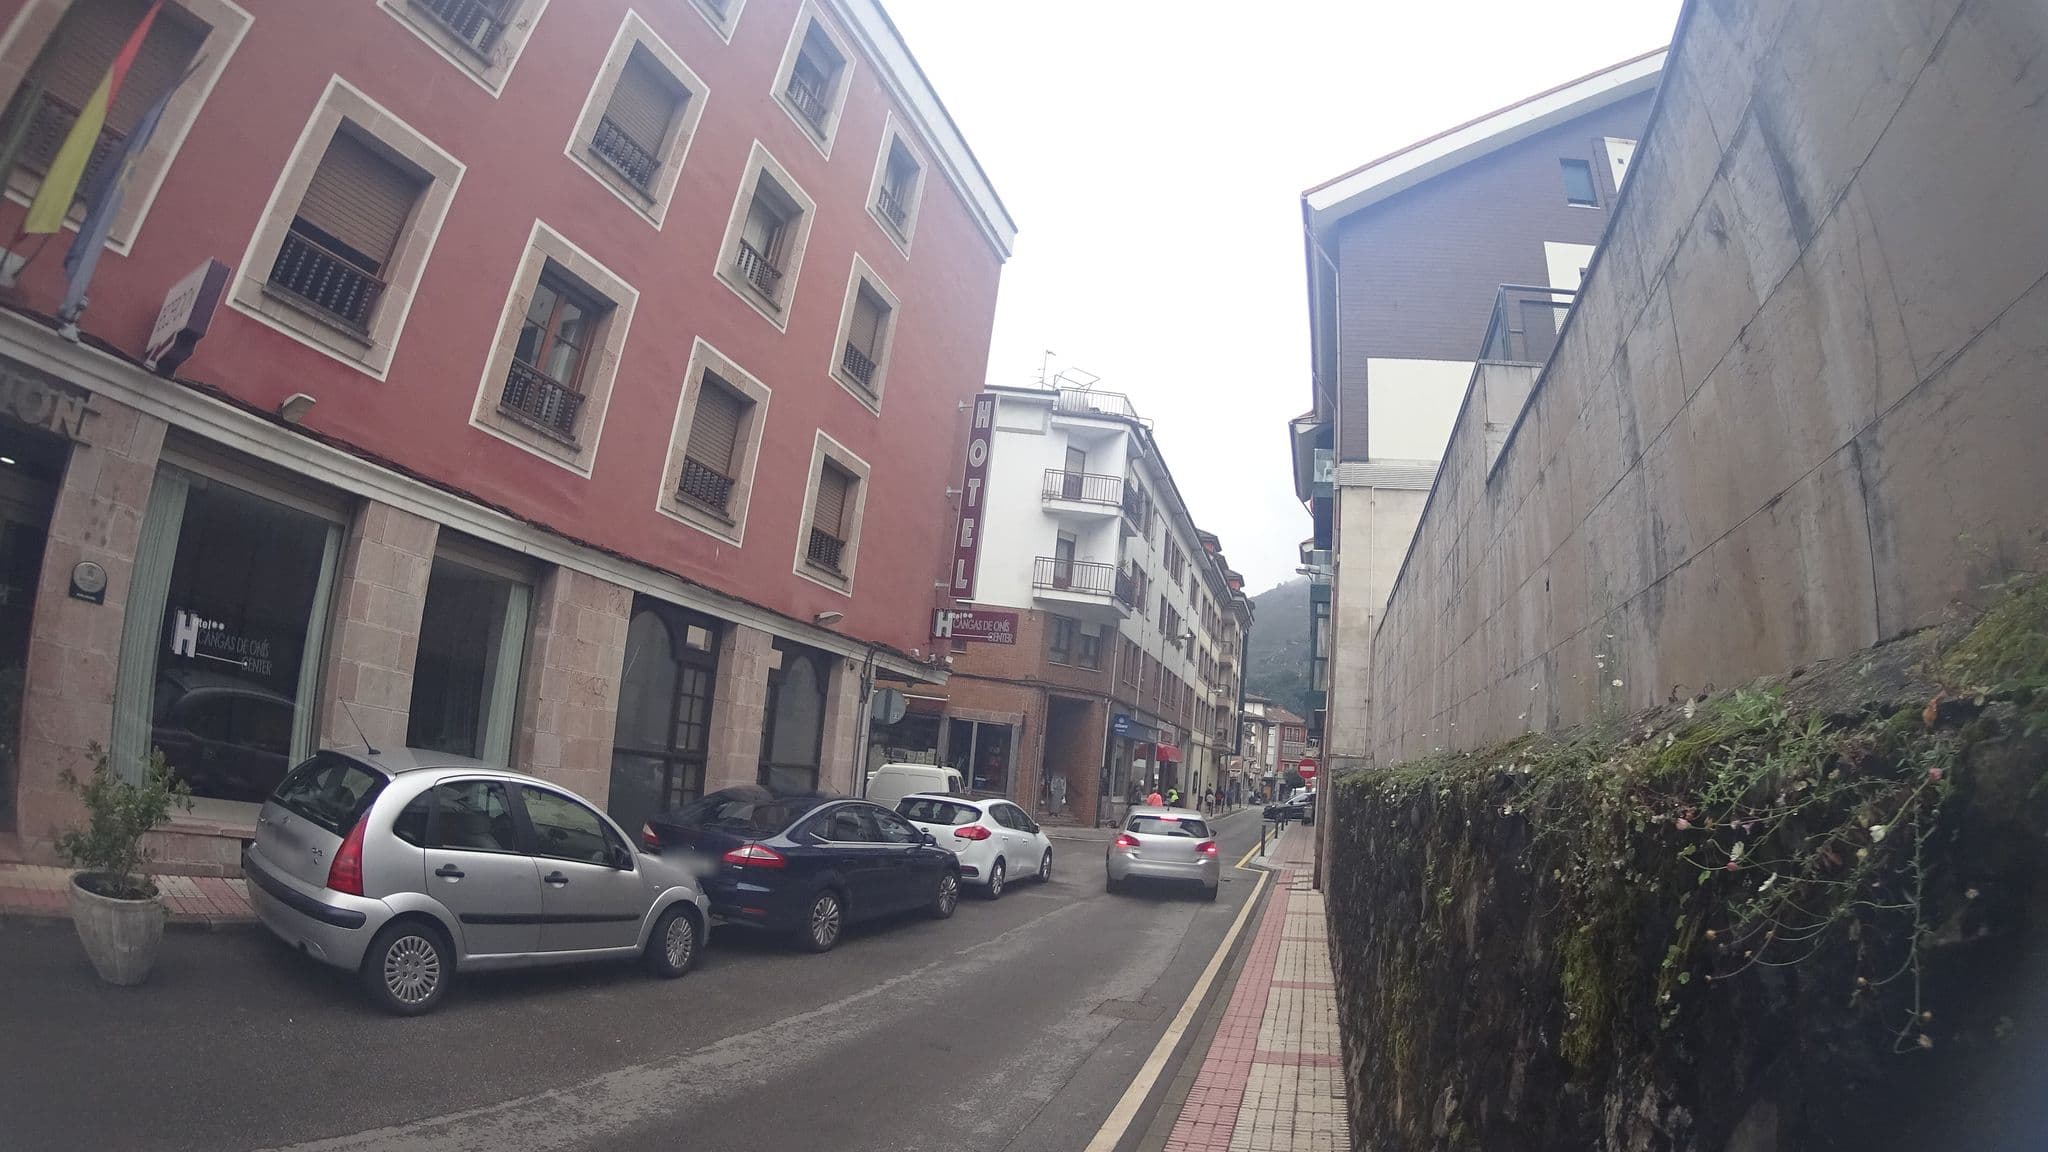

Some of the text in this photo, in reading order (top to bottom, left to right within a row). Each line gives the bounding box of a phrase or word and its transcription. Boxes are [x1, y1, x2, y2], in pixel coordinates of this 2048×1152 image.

[955, 401, 992, 589] HOTEL
[953, 619, 981, 630] CANGAS
[983, 620, 993, 631] DE
[198, 630, 235, 650] CANGAS
[236, 638, 248, 654] DE
[988, 632, 1014, 643] CENTER
[241, 658, 272, 676] CENTER
